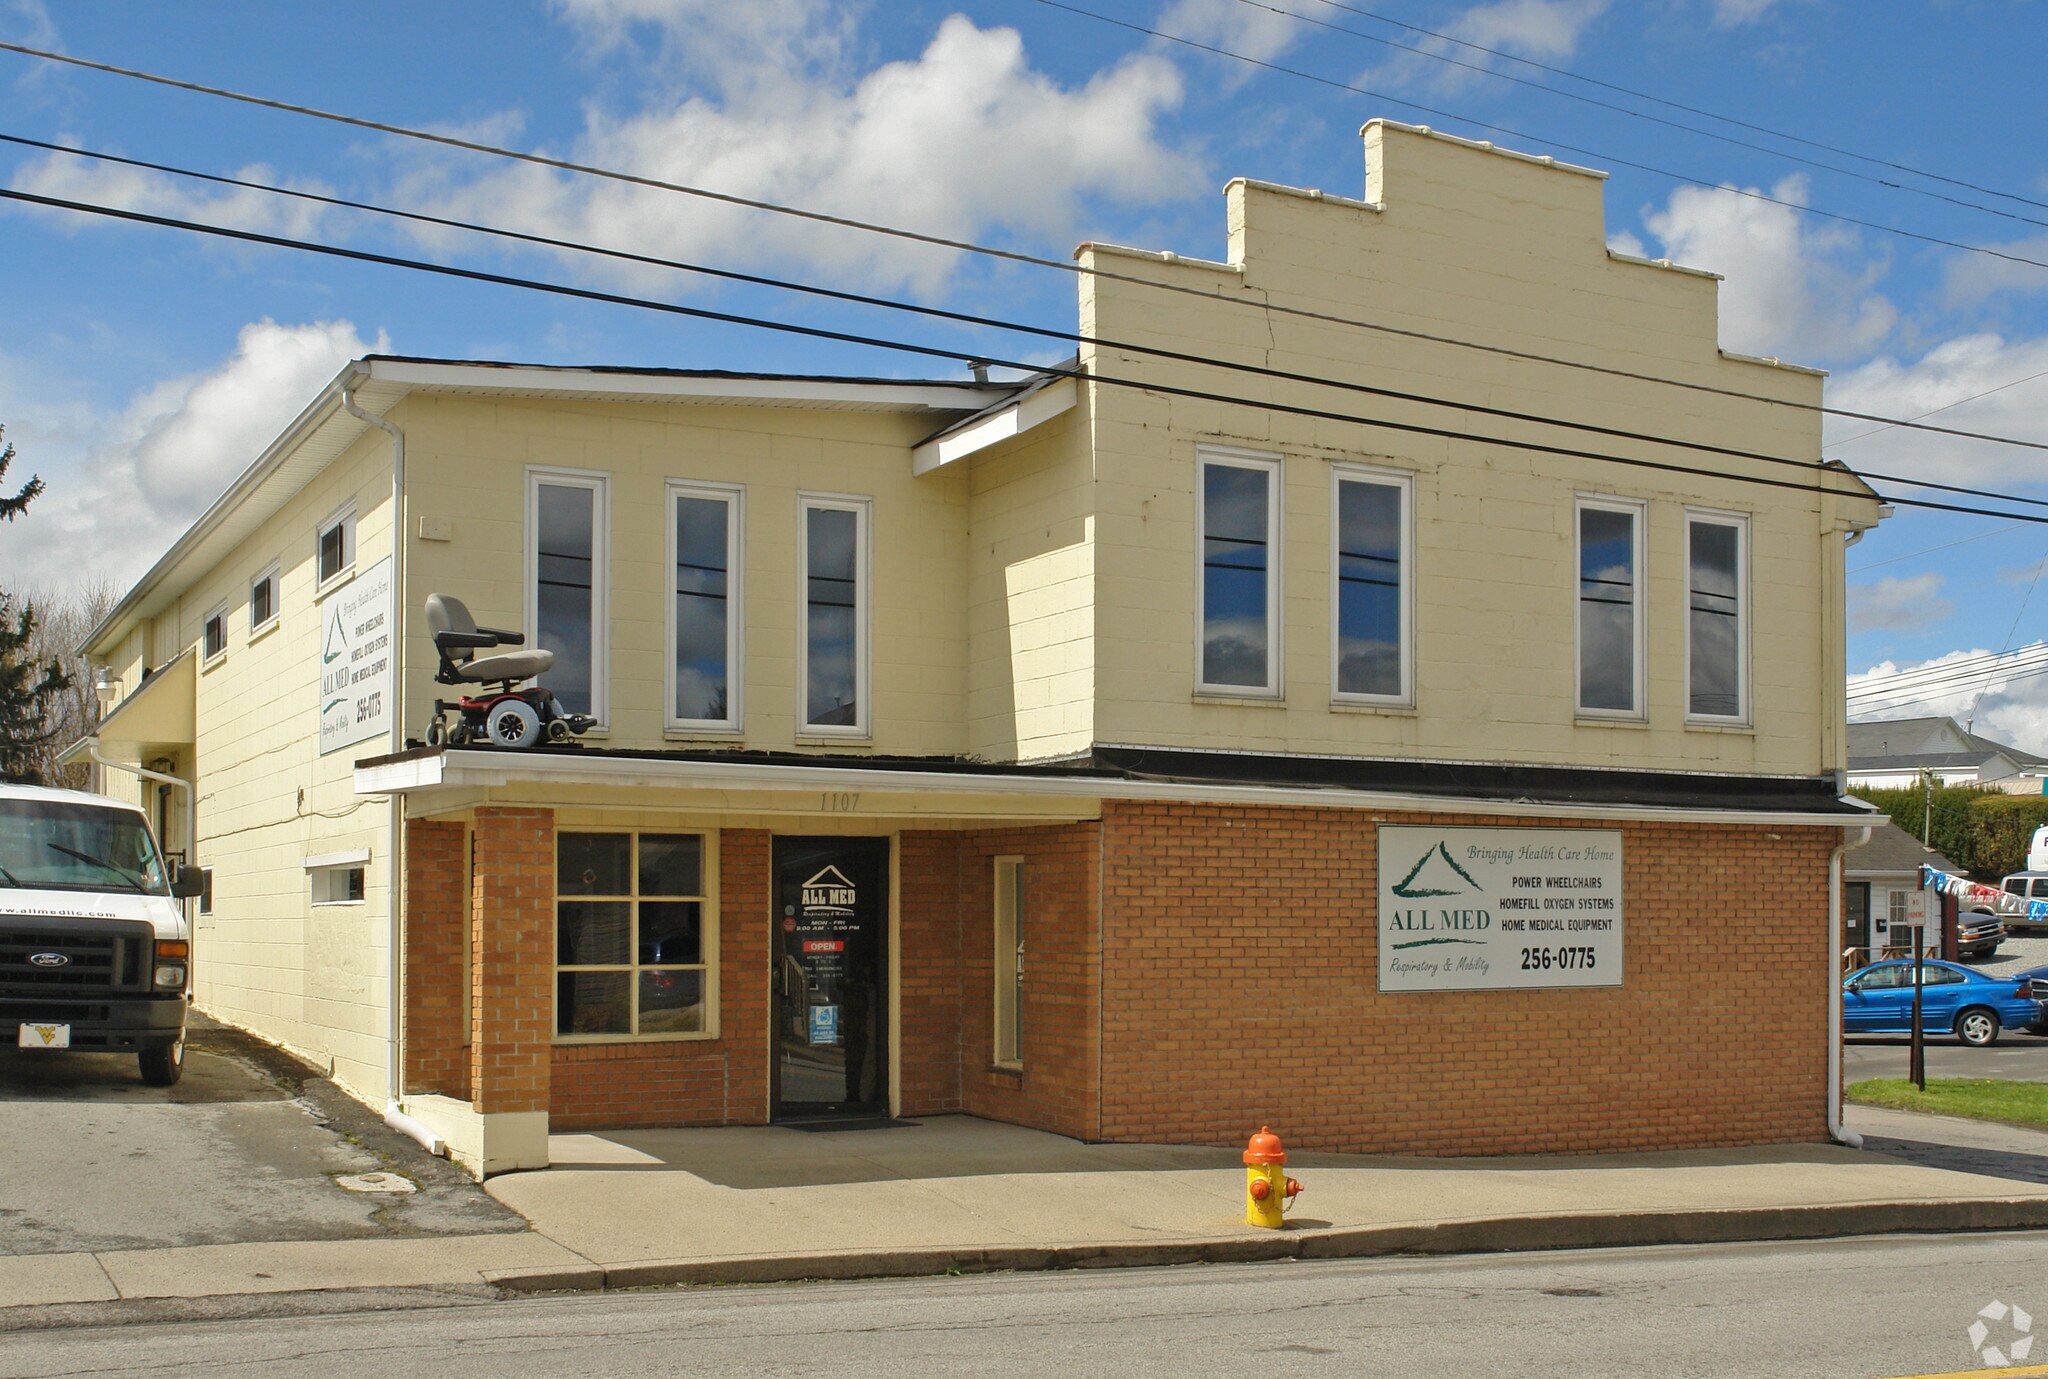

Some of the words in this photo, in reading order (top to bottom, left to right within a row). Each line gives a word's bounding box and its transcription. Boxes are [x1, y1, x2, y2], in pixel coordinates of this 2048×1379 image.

[322, 673, 334, 697] ALL
[335, 666, 349, 691] MED
[356, 691, 381, 724] 256-0775
[821, 792, 860, 811] 1107
[1466, 844, 1514, 864] Bringing
[1518, 844, 1555, 860] Health
[1558, 846, 1580, 861] Care
[1584, 846, 1614, 861] Home
[1512, 876, 1542, 888] POWER
[1545, 876, 1602, 889] WHEELCHAIRS
[802, 889, 826, 905] ALL
[829, 889, 856, 905] MED
[1500, 898, 1540, 910] HOMEFILL
[1544, 898, 1575, 910] OXYGEN
[1578, 898, 1614, 910] SYSTEMS
[0, 908, 116, 918] w.allmedllc.com
[1388, 910, 1435, 930] ALL
[1440, 909, 1490, 930] MED
[1501, 920, 1525, 931] HOME
[1528, 919, 1564, 931] MEDICAL
[1568, 919, 1613, 932] EQUIPMENT
[39, 955, 60, 964] Ford
[1389, 956, 1438, 977] Respiratory
[1443, 958, 1453, 972] &
[1456, 956, 1490, 976] Mobility
[1521, 947, 1596, 970] 256-0775
